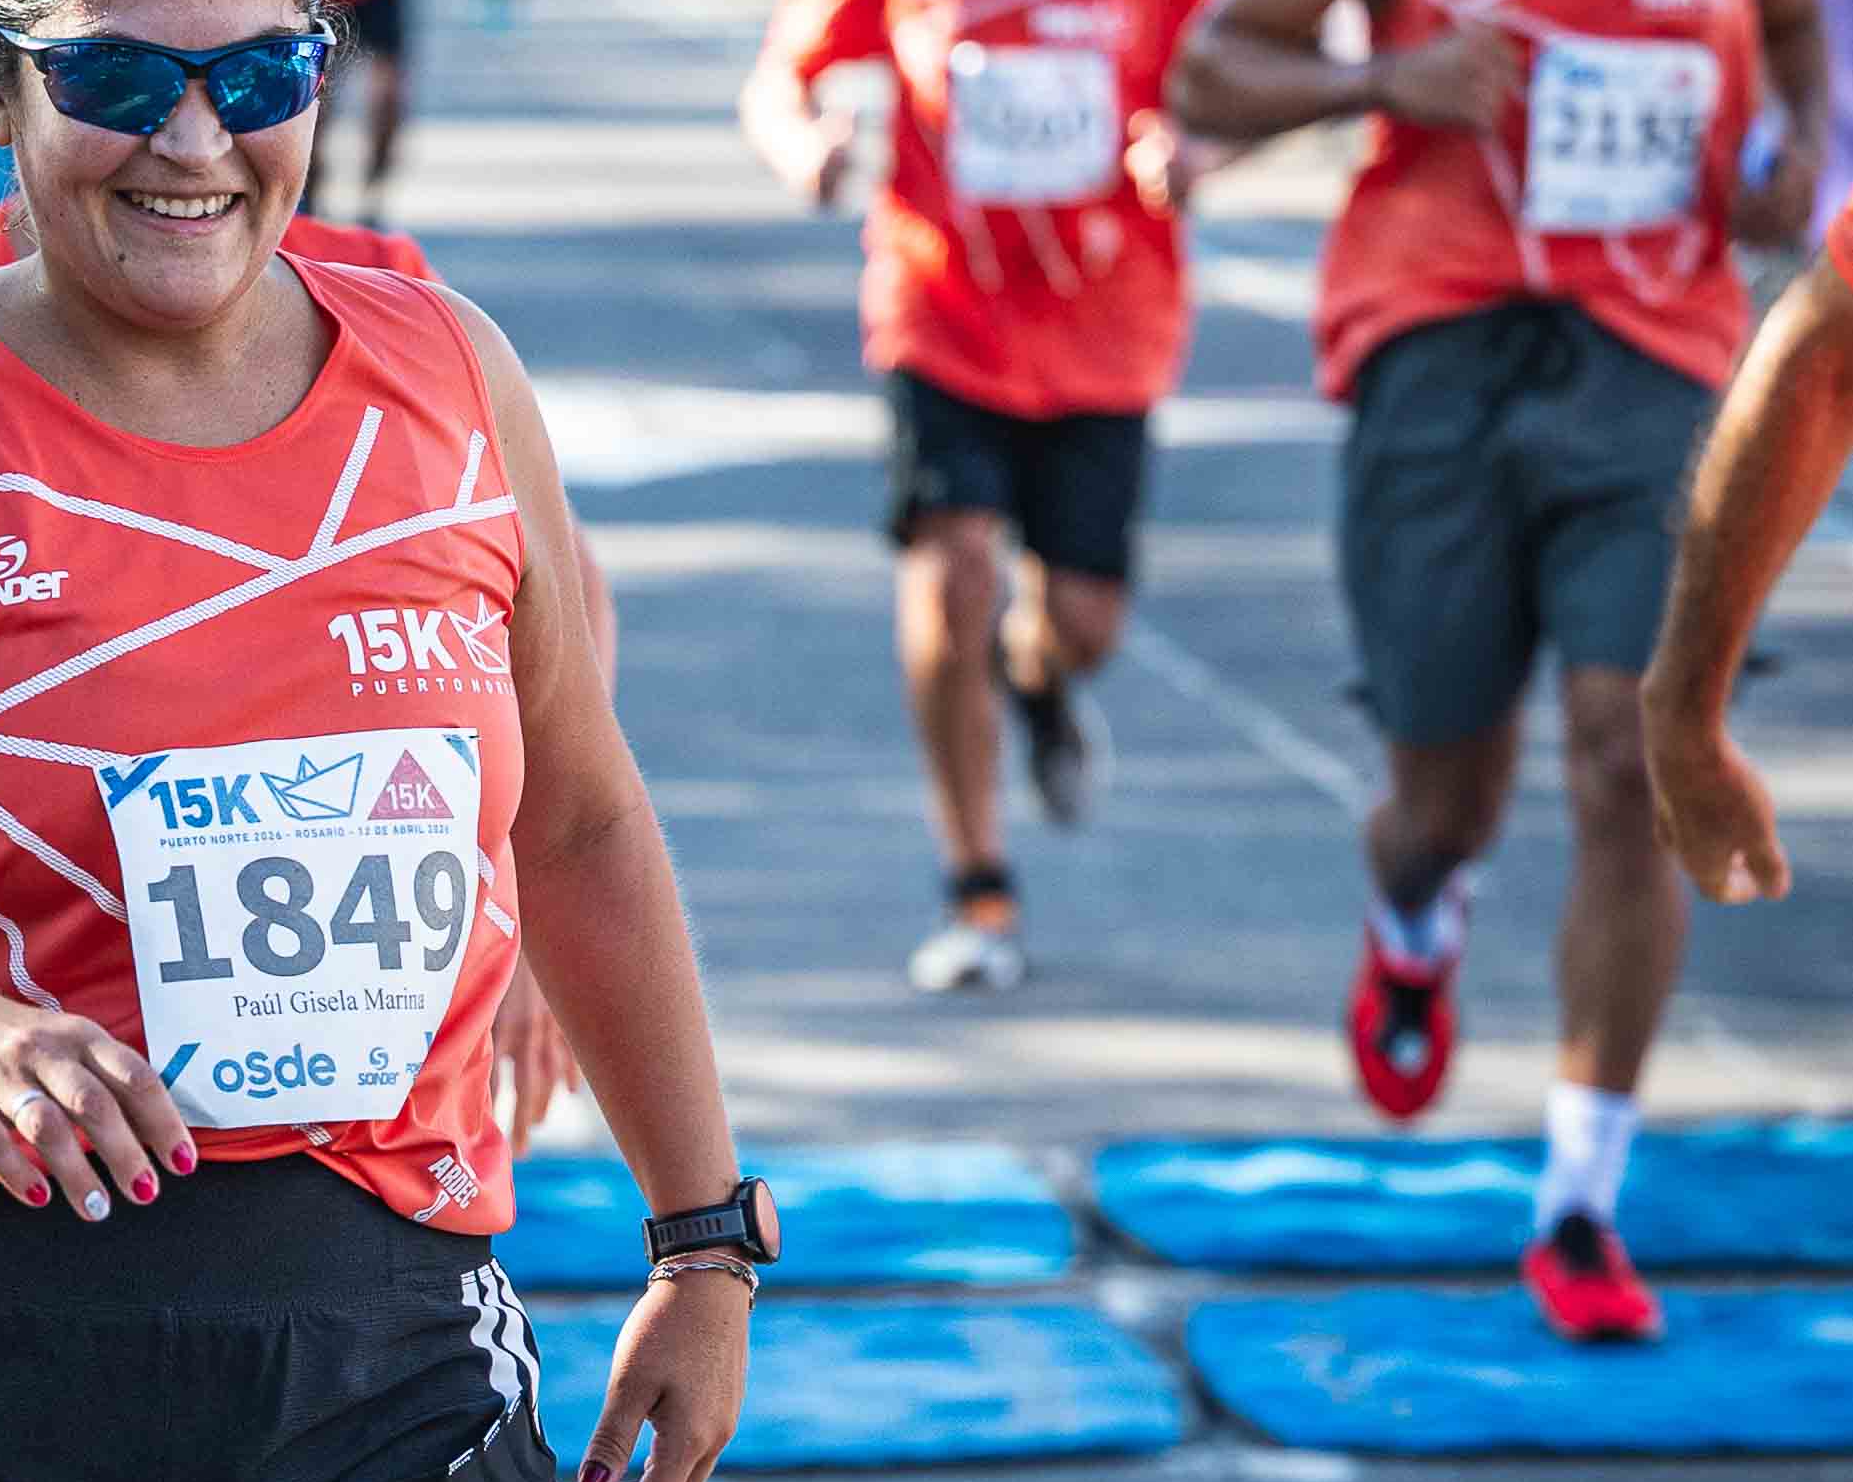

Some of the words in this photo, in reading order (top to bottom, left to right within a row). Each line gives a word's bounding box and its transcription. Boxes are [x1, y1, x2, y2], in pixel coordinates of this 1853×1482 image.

[327, 608, 457, 675] 15K
[351, 678, 463, 696] PUERTO
[148, 773, 261, 829] 15K
[386, 783, 436, 811] 15K
[160, 835, 206, 847] PUERTO
[211, 833, 249, 845] NORTE
[254, 831, 282, 842] 2026
[295, 826, 345, 838] ROSARIO
[374, 825, 388, 835] DE
[393, 824, 425, 835] ABRIL
[147, 850, 466, 983] 1849
[233, 992, 283, 1017] Paúl
[290, 989, 358, 1014] Gisela
[364, 987, 424, 1011] Marina
[212, 1043, 336, 1095] osde
